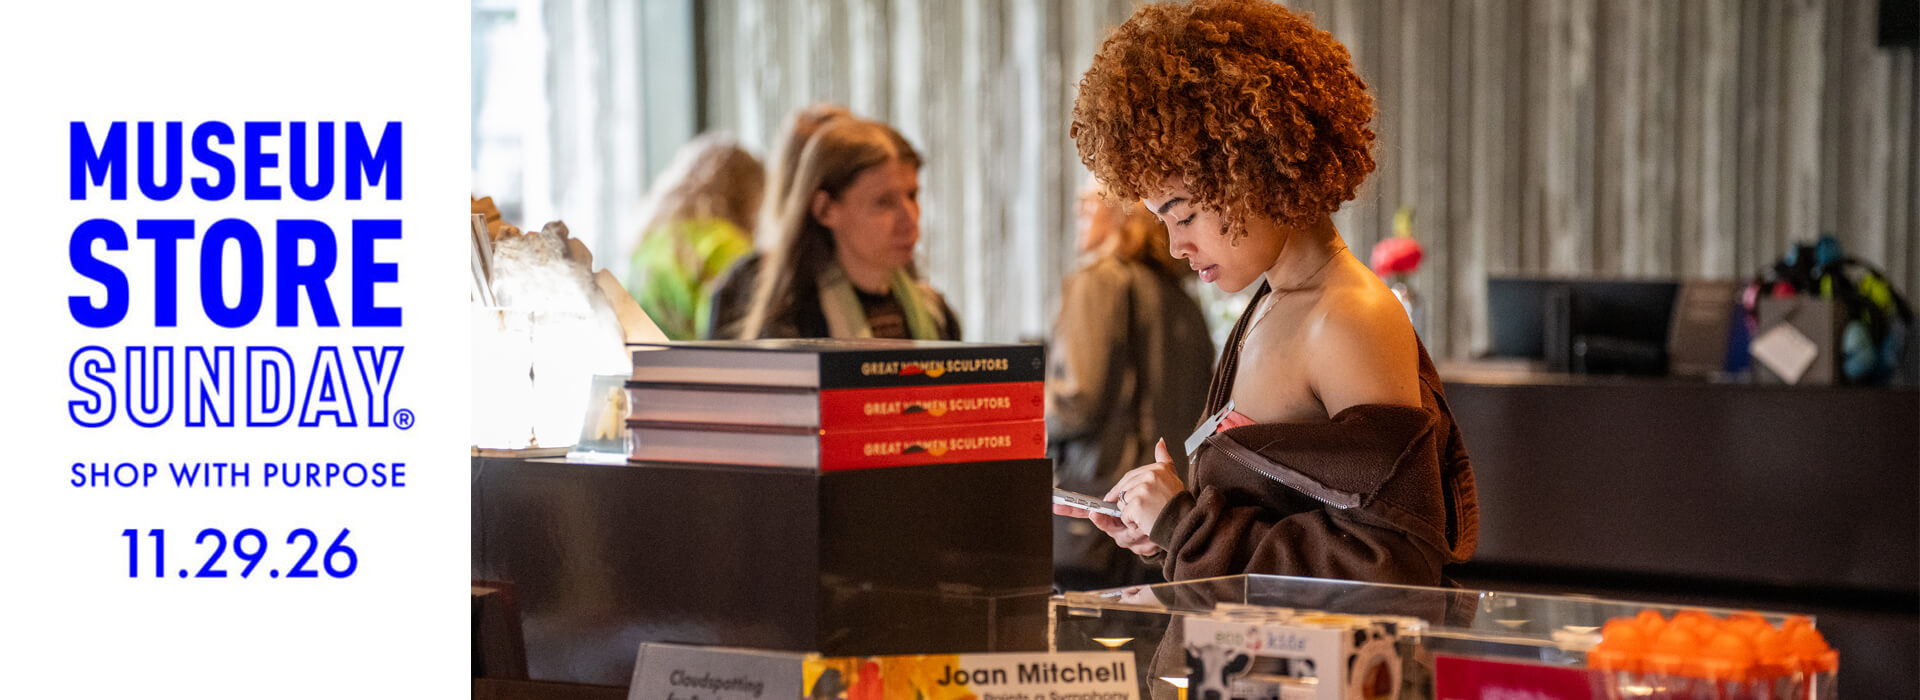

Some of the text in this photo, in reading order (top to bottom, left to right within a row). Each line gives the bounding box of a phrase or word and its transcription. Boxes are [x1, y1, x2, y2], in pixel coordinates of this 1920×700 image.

[861, 361, 899, 376] GREAT
[947, 358, 1009, 373] SCULPTORS
[864, 402, 901, 416] GREAT
[950, 397, 1010, 412] SCULPTORS
[864, 442, 901, 456] GREAT
[950, 436, 1011, 451] SCULPTORS
[669, 669, 764, 698] Cloudspotting
[937, 662, 1126, 686] Joan Mitchell
